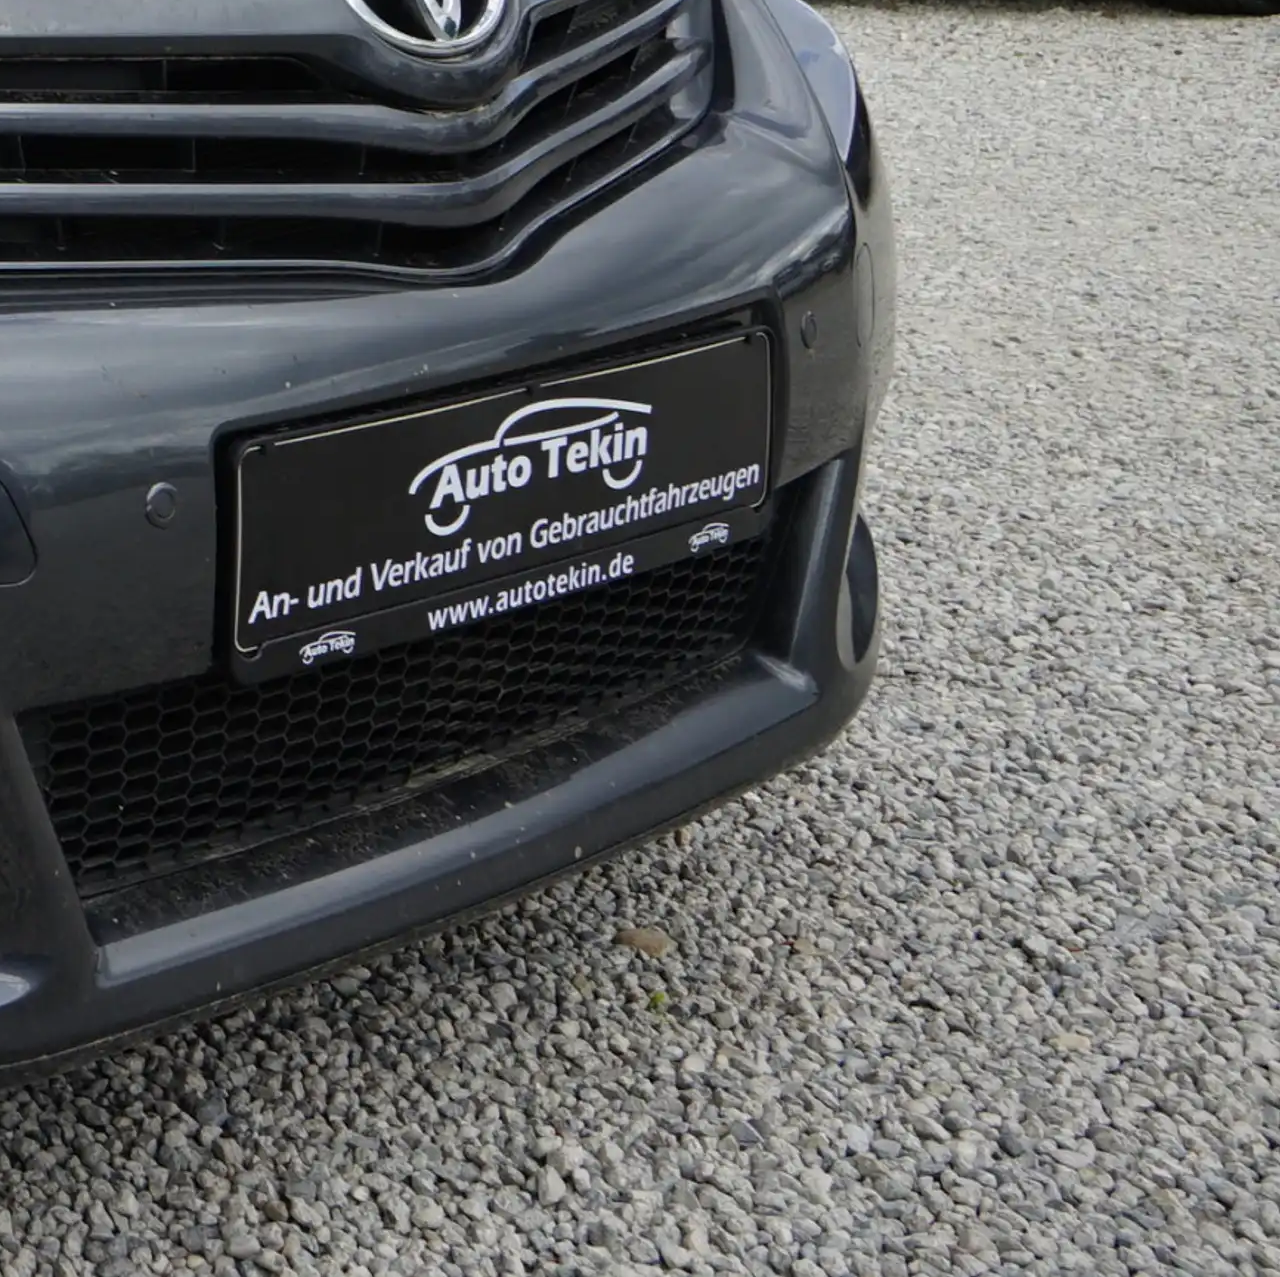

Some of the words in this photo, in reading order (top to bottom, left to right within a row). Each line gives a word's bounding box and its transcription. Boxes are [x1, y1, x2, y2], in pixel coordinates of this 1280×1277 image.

[429, 453, 531, 509] Auto
[541, 422, 647, 478] Tekin
[248, 591, 299, 624] An-
[307, 567, 362, 609] und
[370, 538, 472, 591] Verkauf
[477, 531, 523, 564] von
[530, 463, 760, 549] Gebrauchtfahrzeugen
[428, 552, 635, 631] www.autotekin.de
